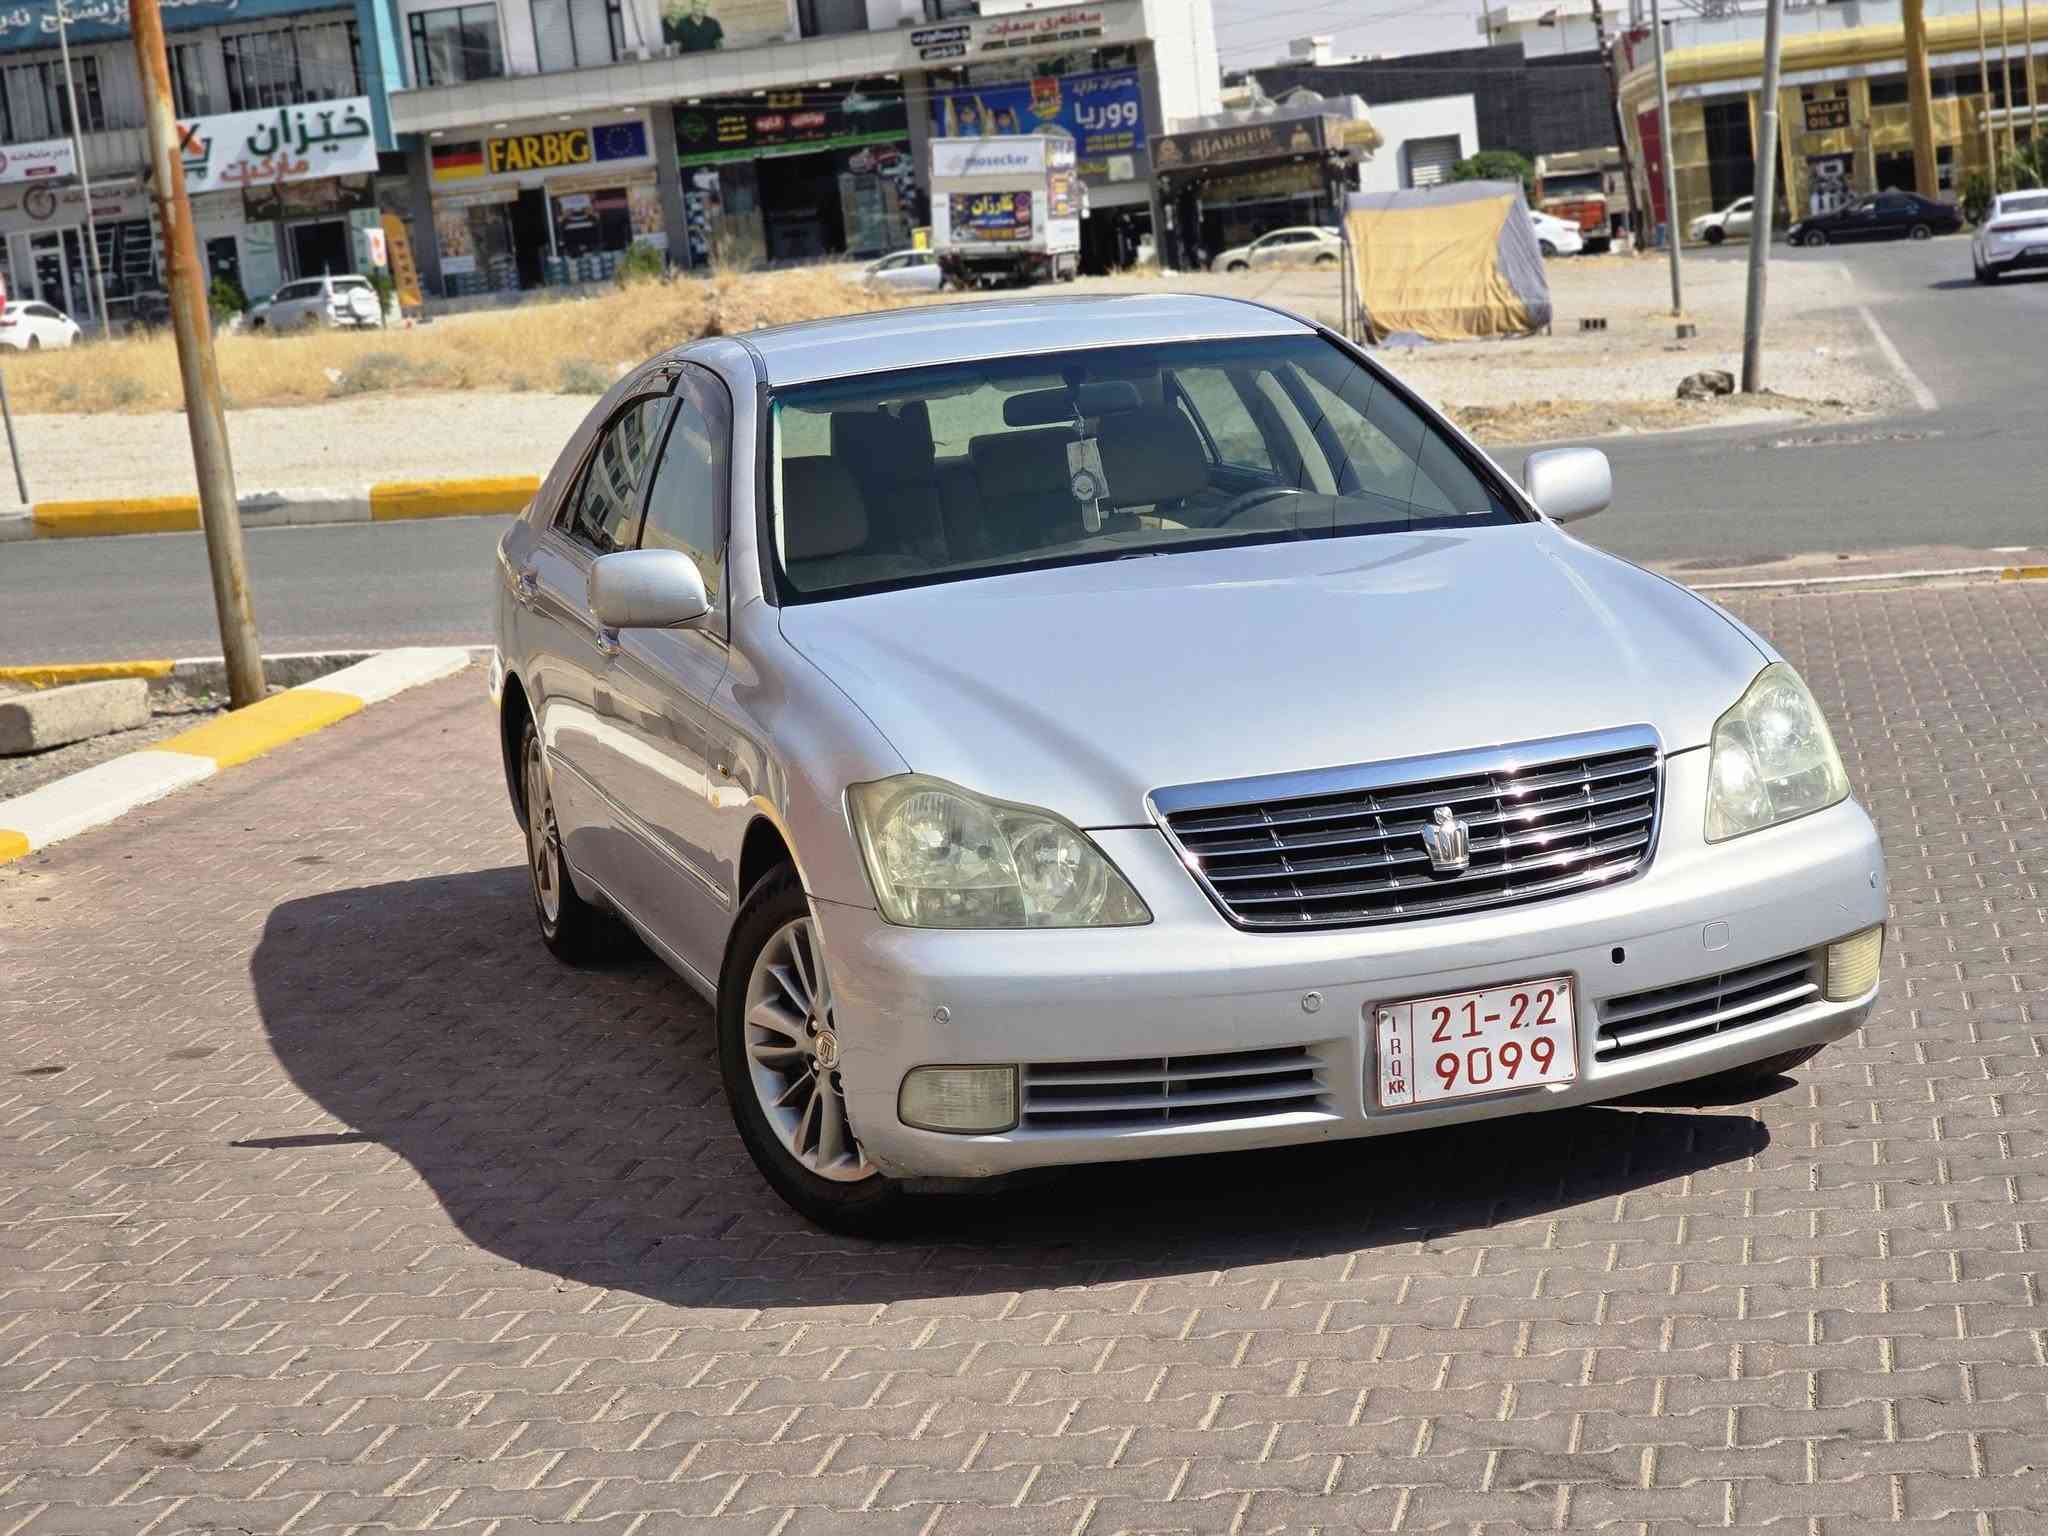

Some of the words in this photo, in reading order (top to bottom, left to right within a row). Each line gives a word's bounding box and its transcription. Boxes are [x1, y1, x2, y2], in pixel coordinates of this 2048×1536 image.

[246, 105, 371, 156] خێزان
[1074, 101, 1138, 129] ووریا
[1431, 988, 1556, 1043] 21-22
[1388, 1079, 1406, 1094] KR
[1435, 1036, 1556, 1090] 9099
